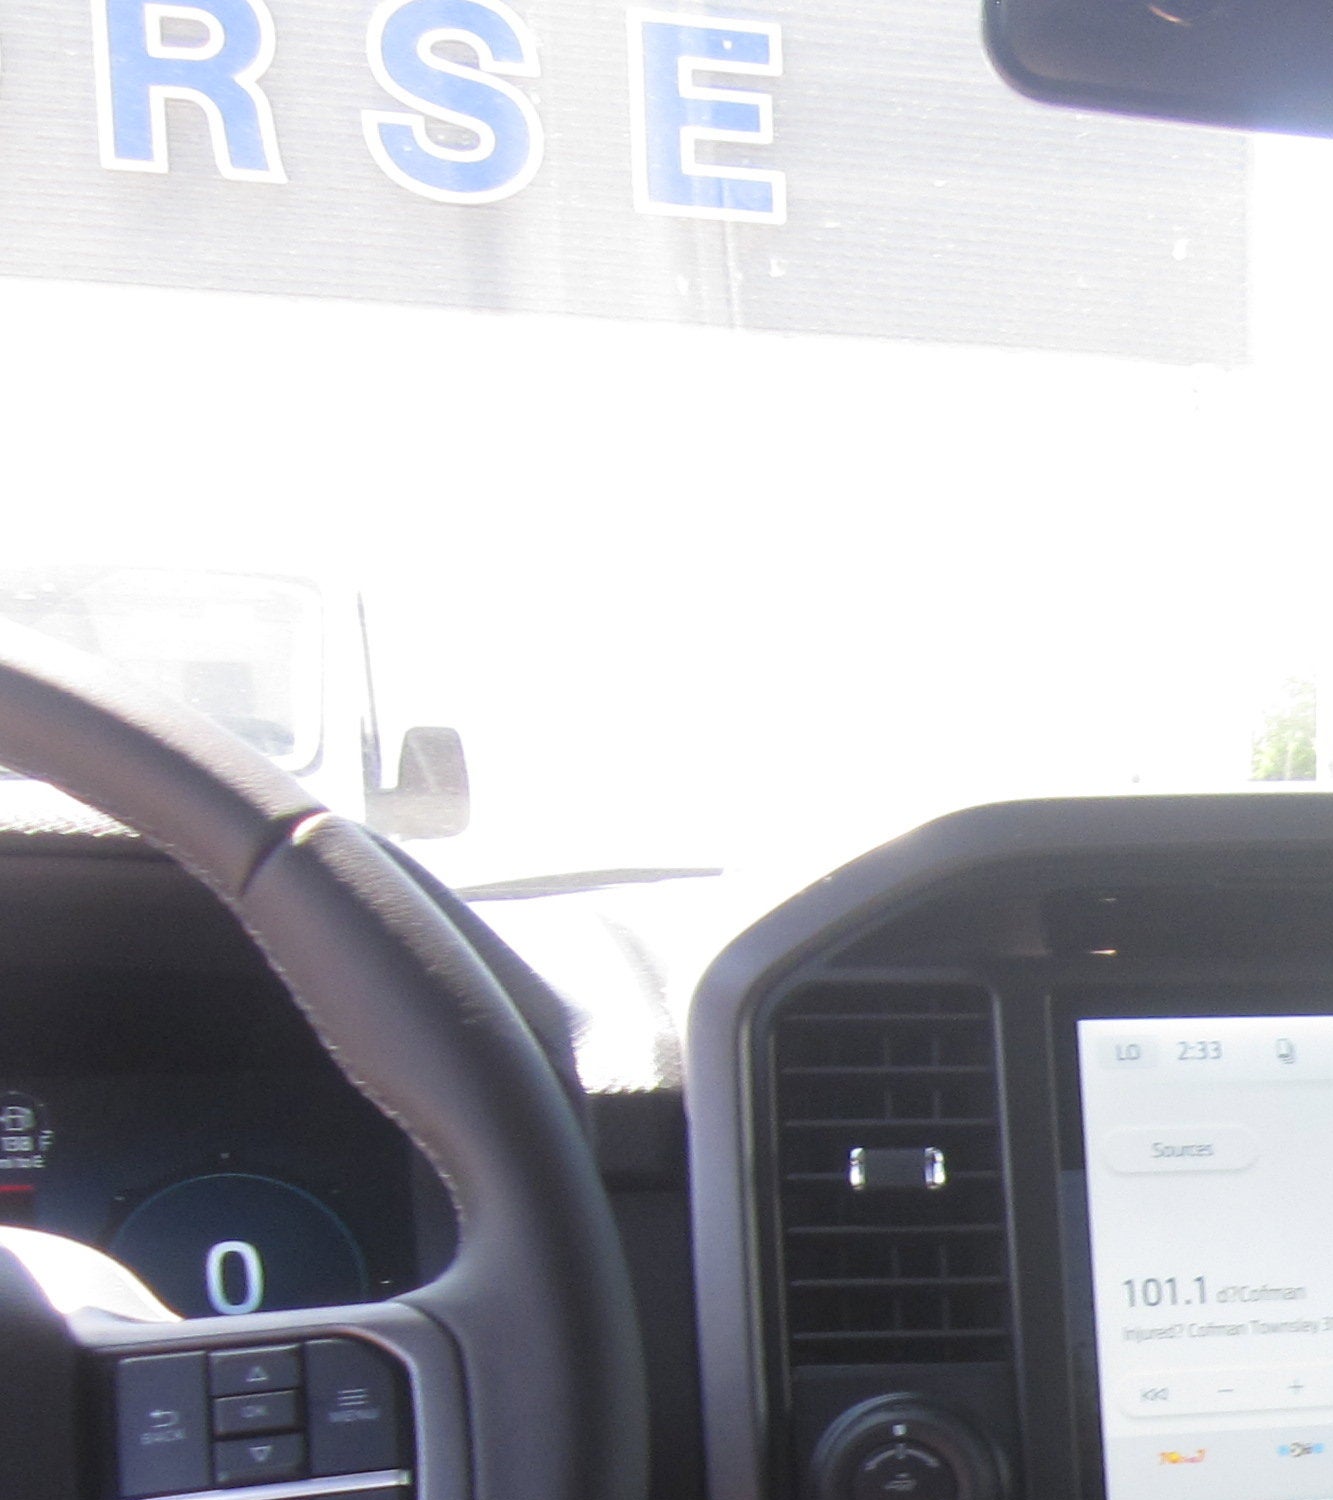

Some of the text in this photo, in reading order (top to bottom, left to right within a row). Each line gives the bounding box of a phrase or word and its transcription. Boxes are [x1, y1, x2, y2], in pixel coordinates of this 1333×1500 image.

[1177, 1040, 1223, 1061] 2:33
[1151, 1142, 1215, 1159] Sources
[206, 1240, 265, 1316] 0
[1121, 1274, 1209, 1308] 101.1
